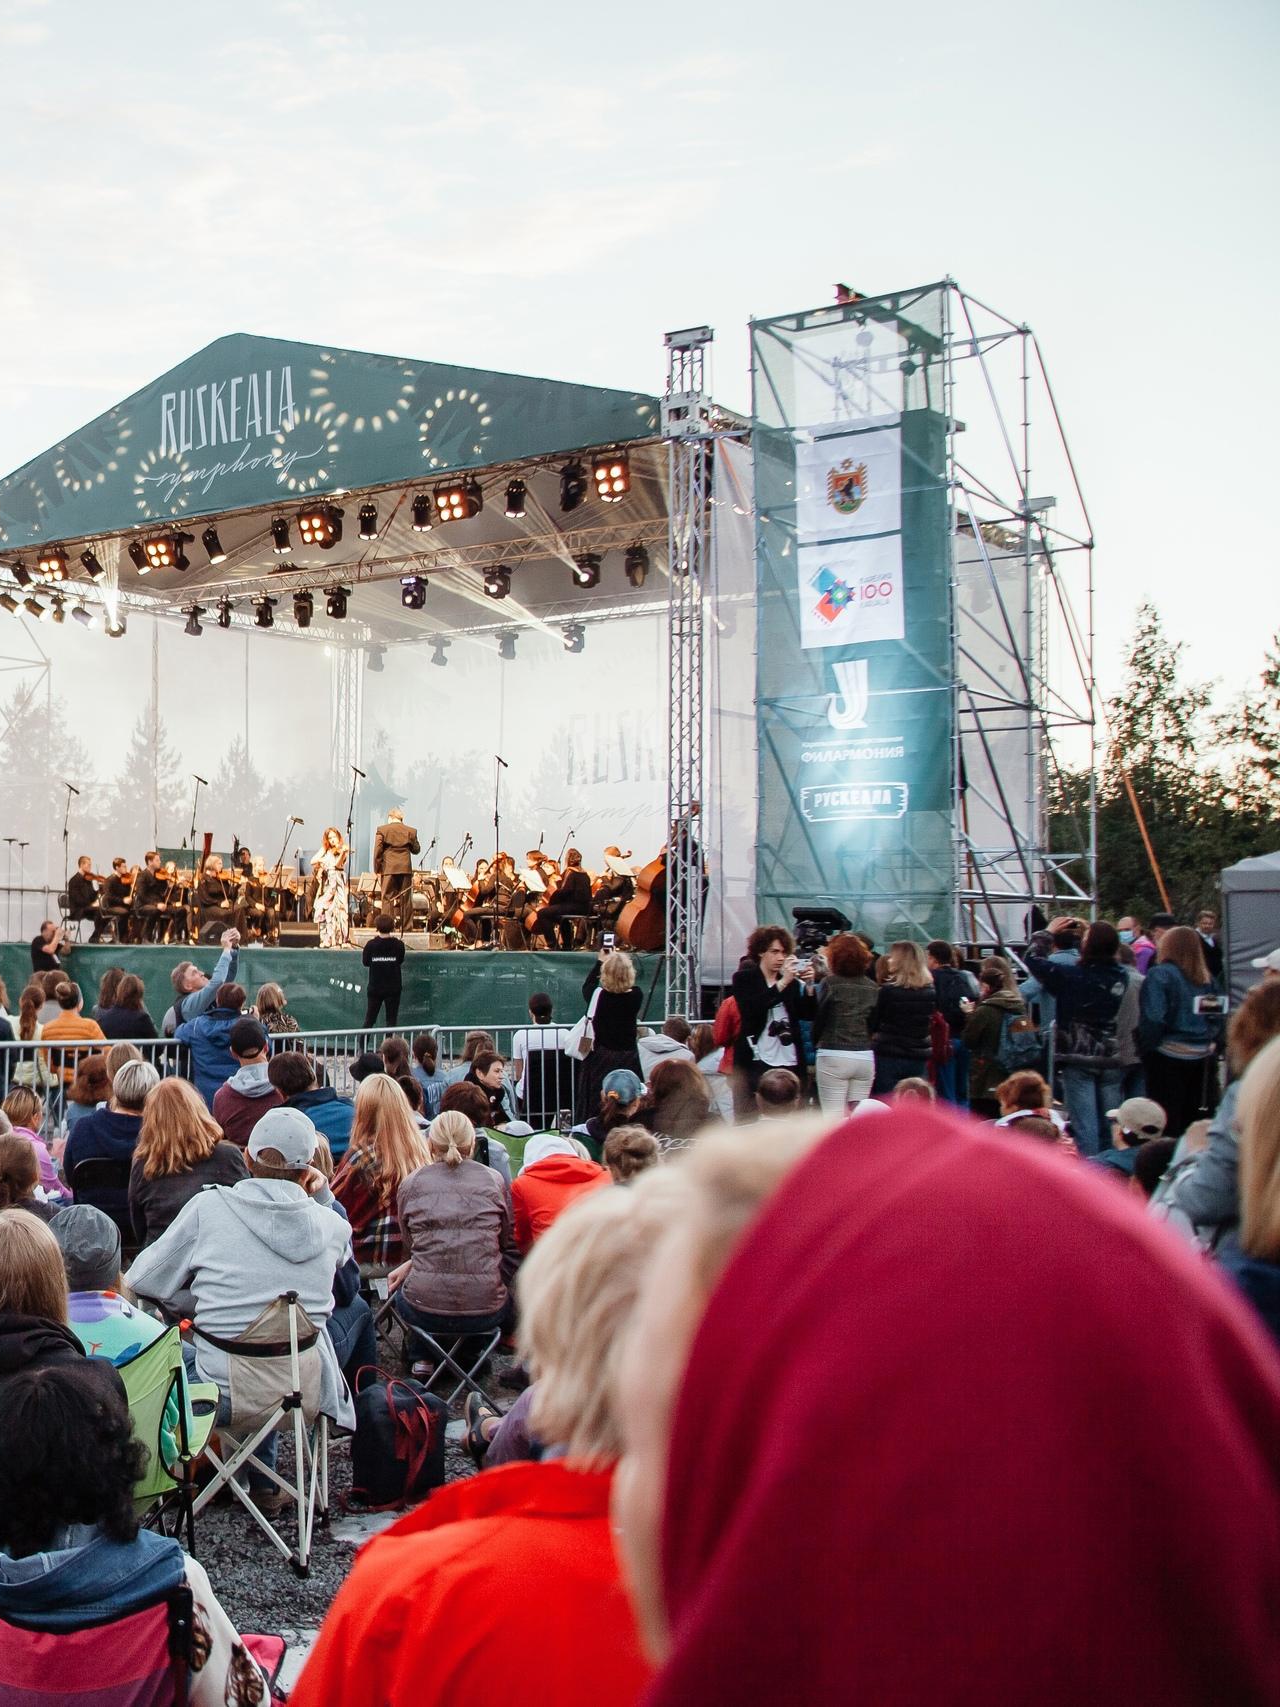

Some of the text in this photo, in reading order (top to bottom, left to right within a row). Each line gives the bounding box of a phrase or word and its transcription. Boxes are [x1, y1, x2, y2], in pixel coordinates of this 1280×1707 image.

[161, 366, 296, 457] RUSKEALA
[142, 442, 324, 503] symphony
[860, 582, 893, 600] 100
[801, 746, 904, 763] ФИЛАРМОНИЯ
[813, 789, 892, 808] РУСКЕАЛА
